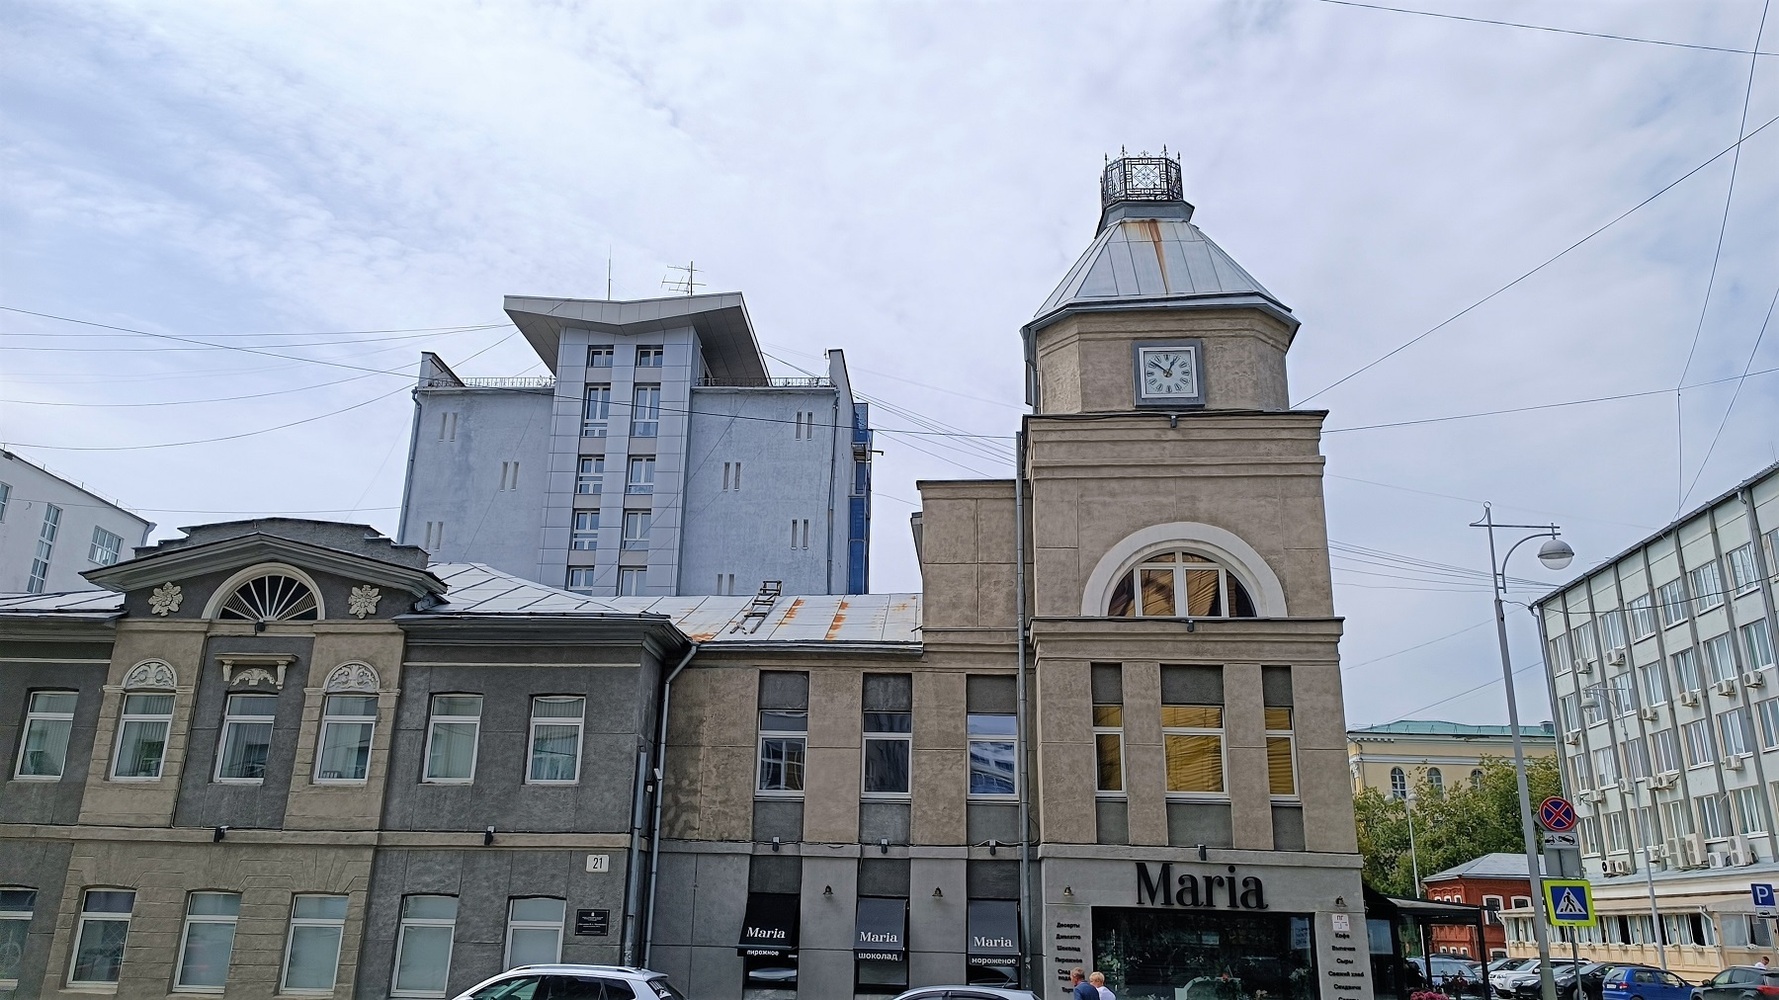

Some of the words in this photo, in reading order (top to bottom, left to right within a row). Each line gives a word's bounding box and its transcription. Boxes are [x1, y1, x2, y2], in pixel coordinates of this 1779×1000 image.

[592, 857, 603, 869] 21
[1135, 862, 1268, 909] Maria
[1756, 886, 1769, 904] P
[746, 926, 786, 938] Maria
[860, 931, 898, 942] Maria
[973, 936, 1013, 947] Maria
[858, 953, 898, 961] шоколад
[971, 957, 1016, 965] мороженое
